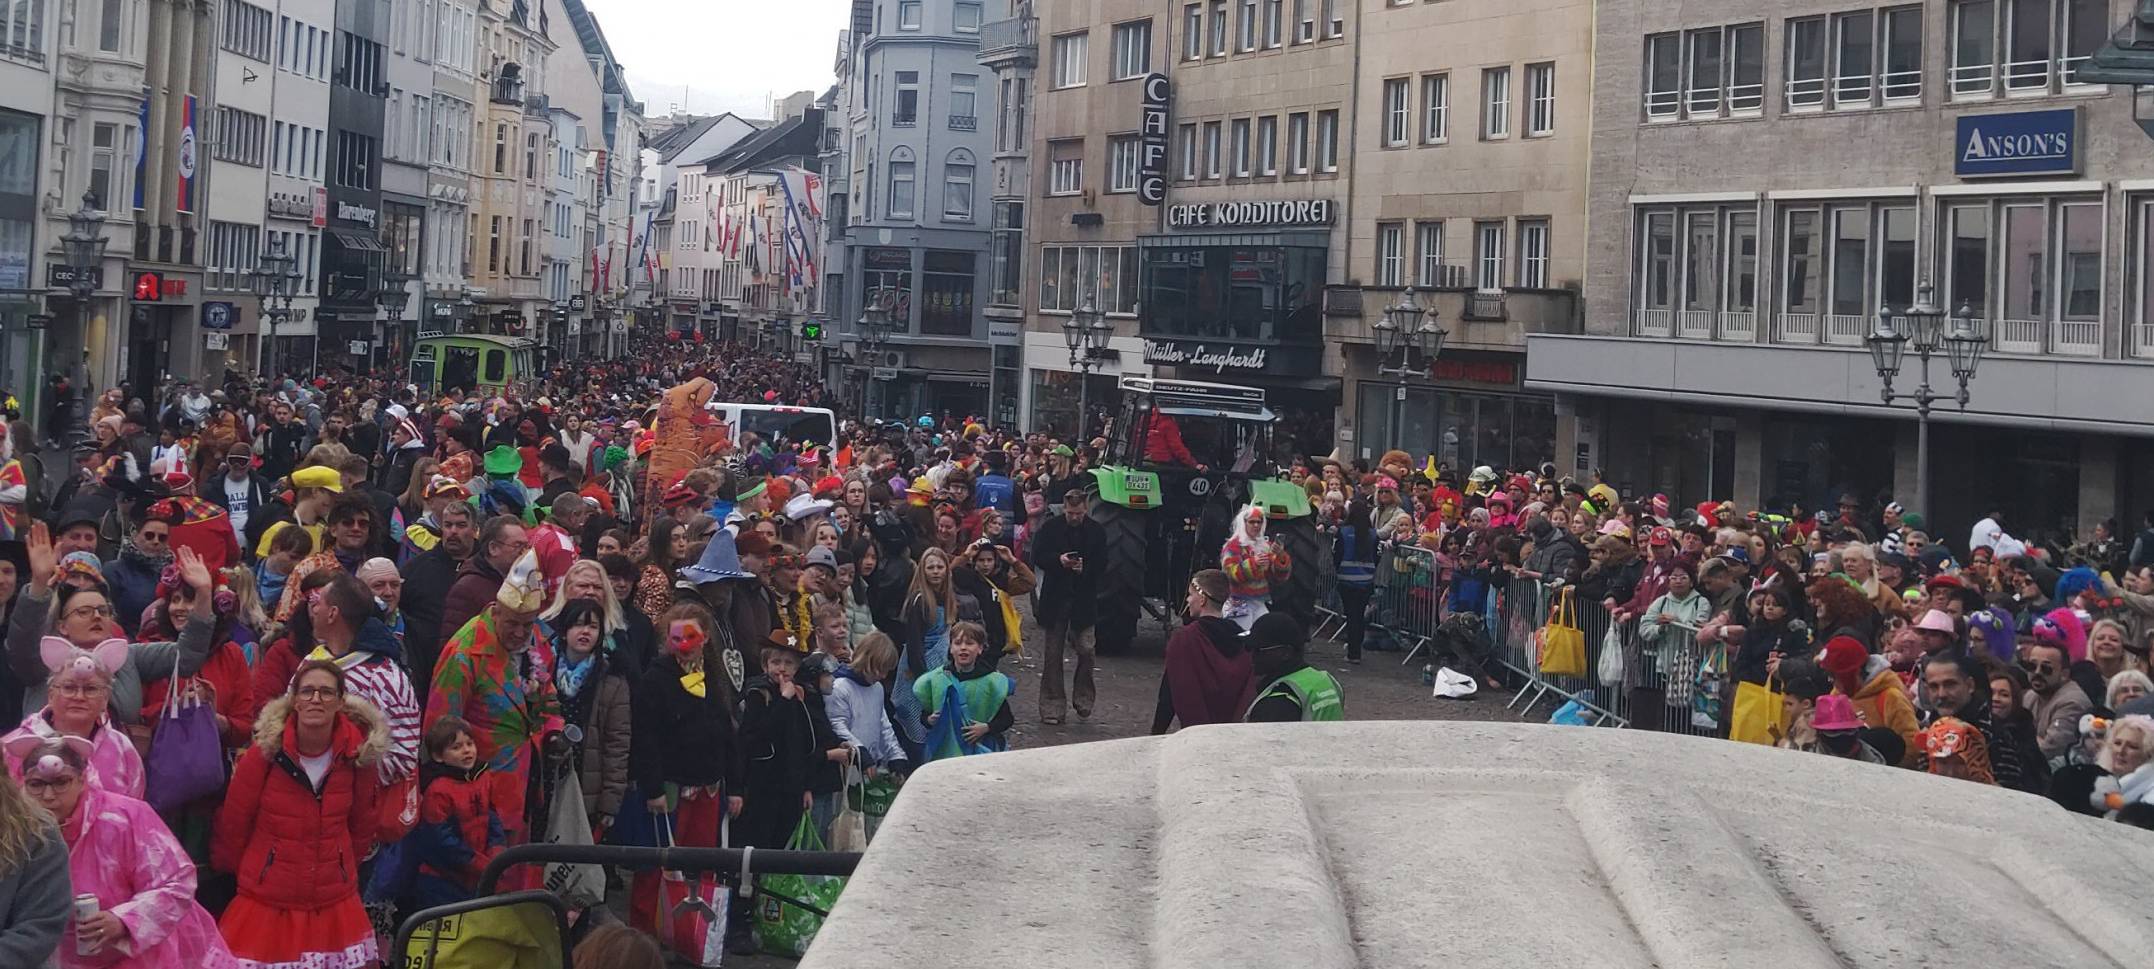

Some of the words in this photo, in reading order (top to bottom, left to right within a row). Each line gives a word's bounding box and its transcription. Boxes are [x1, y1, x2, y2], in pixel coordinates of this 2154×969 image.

[1142, 78, 1168, 201] CAFE
[1963, 127, 2067, 162] ANSON'S
[338, 200, 376, 228] Harenberg
[1169, 204, 1207, 226] CAFE
[1215, 199, 1327, 224] KONDITOREI
[1143, 339, 1265, 374] Müller-Langhardt
[1155, 384, 1208, 393] DEUTZ-FAHR
[1192, 480, 1207, 493] 40
